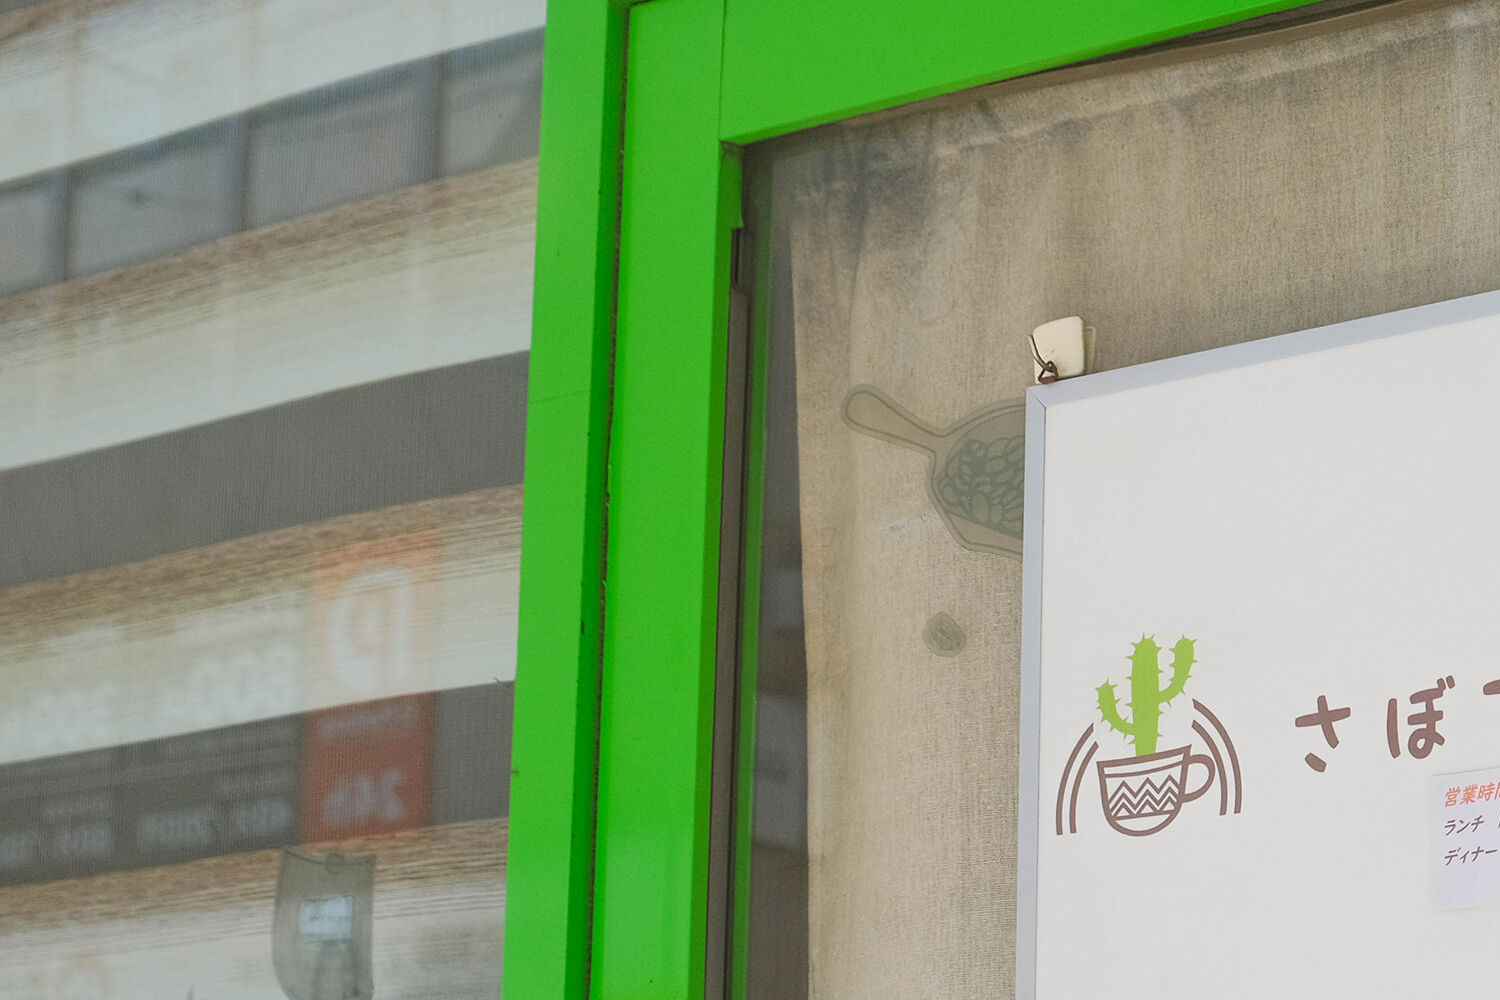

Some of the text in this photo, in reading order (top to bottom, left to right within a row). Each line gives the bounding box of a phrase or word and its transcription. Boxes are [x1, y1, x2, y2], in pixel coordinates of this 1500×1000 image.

[1444, 814, 1485, 836] ランチ
[1444, 846, 1498, 866] ディナー
